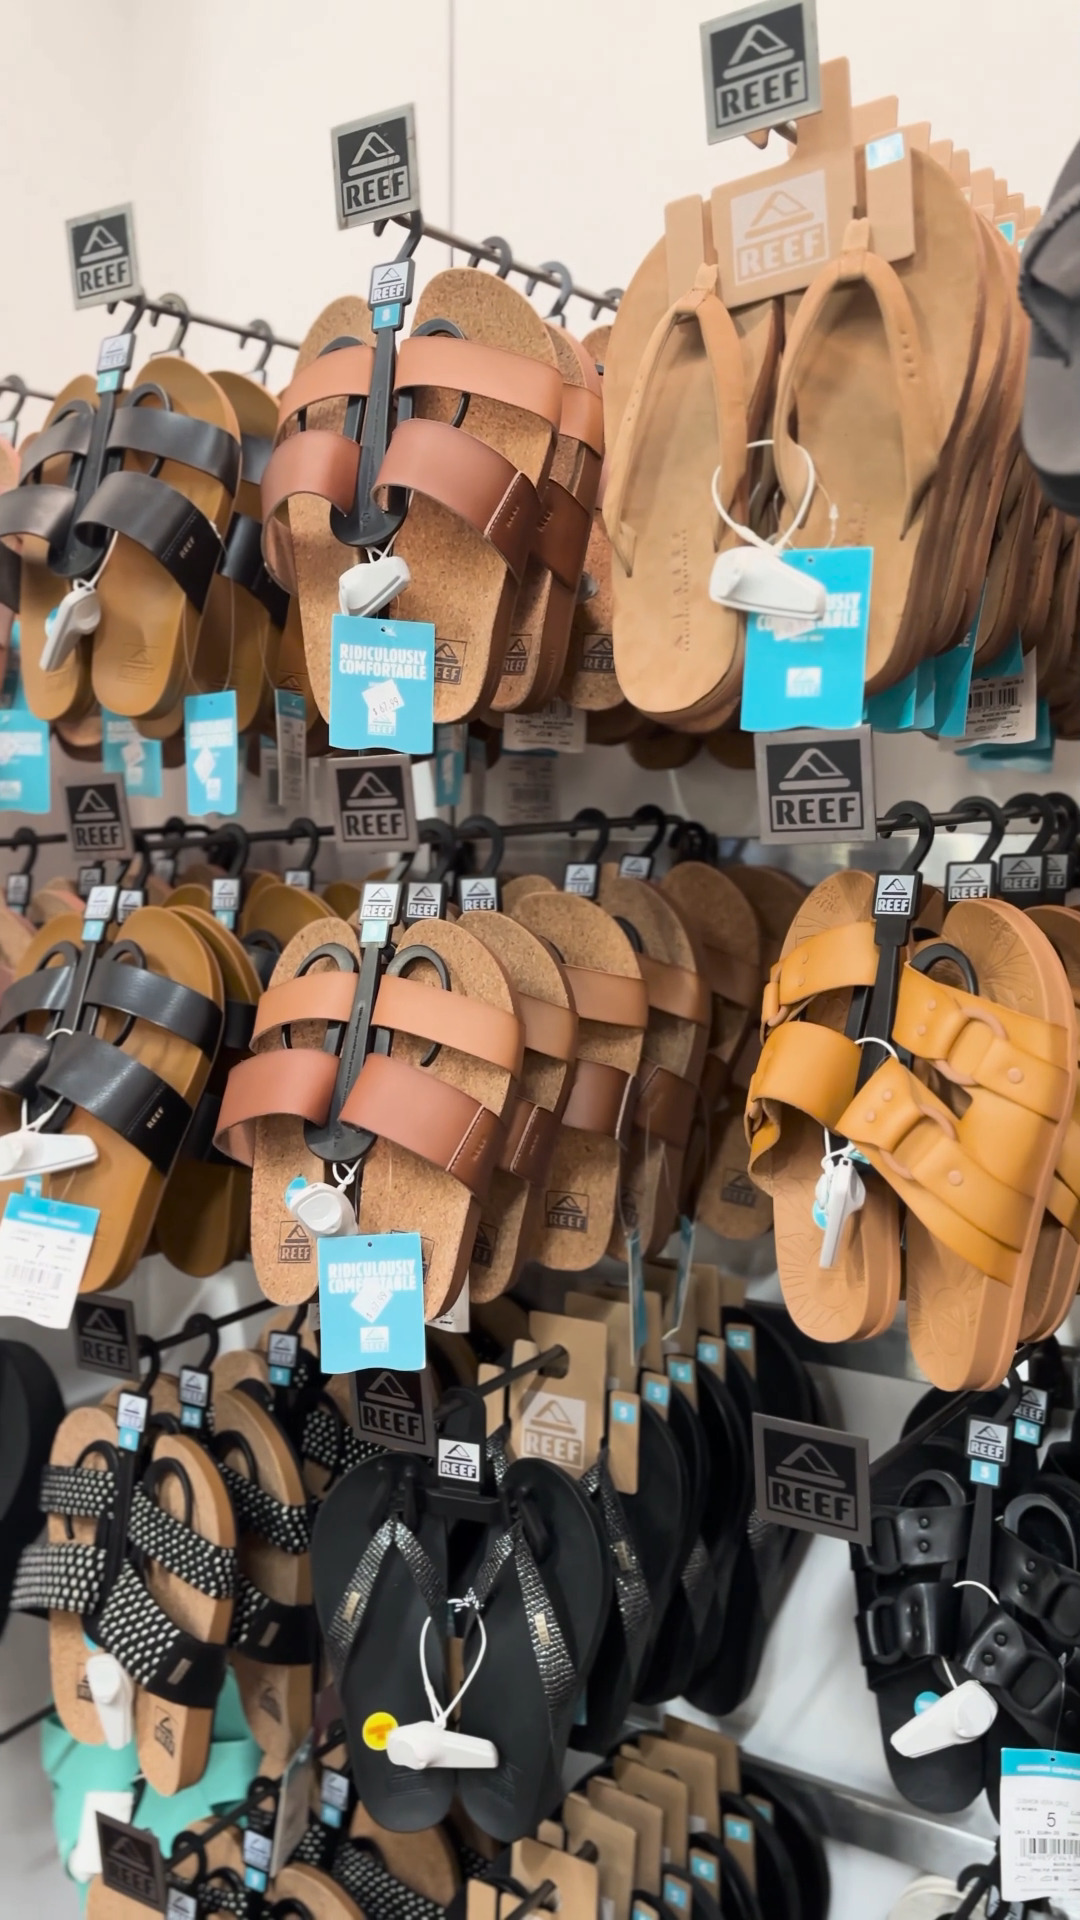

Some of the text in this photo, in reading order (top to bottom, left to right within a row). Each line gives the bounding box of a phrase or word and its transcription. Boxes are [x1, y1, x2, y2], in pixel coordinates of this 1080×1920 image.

[720, 67, 800, 119] REEF
[345, 170, 405, 210] REEF
[739, 226, 821, 280] REEF
[79, 260, 128, 293] REEF
[373, 283, 404, 301] REEF
[339, 643, 427, 664] RIDICULOUSLY
[339, 659, 427, 681] COMFORTABLE
[436, 666, 460, 680] EEF
[504, 659, 526, 672] REEF
[776, 797, 856, 825] REEF
[345, 814, 402, 836] REEF
[76, 825, 121, 846] REEF
[1004, 877, 1039, 889] REEF
[1048, 875, 1065, 886] EF
[951, 886, 988, 899] REEF
[363, 904, 393, 917] REEF
[409, 903, 438, 917] REEF
[464, 898, 495, 911] REEF
[877, 898, 910, 912] REEF
[146, 1106, 164, 1129] REEF
[549, 1213, 586, 1229] REEF
[35, 1244, 45, 1258] 7
[281, 1246, 310, 1260] REEF
[328, 1259, 416, 1278] RIDICULOUSLY
[82, 1342, 128, 1366] REEF
[362, 1405, 421, 1437] REEF
[525, 1433, 582, 1462] REEF
[970, 1441, 1004, 1459] REEF
[441, 1461, 477, 1479] REEF
[772, 1481, 851, 1521] REEF
[1046, 1812, 1057, 1828] 5
